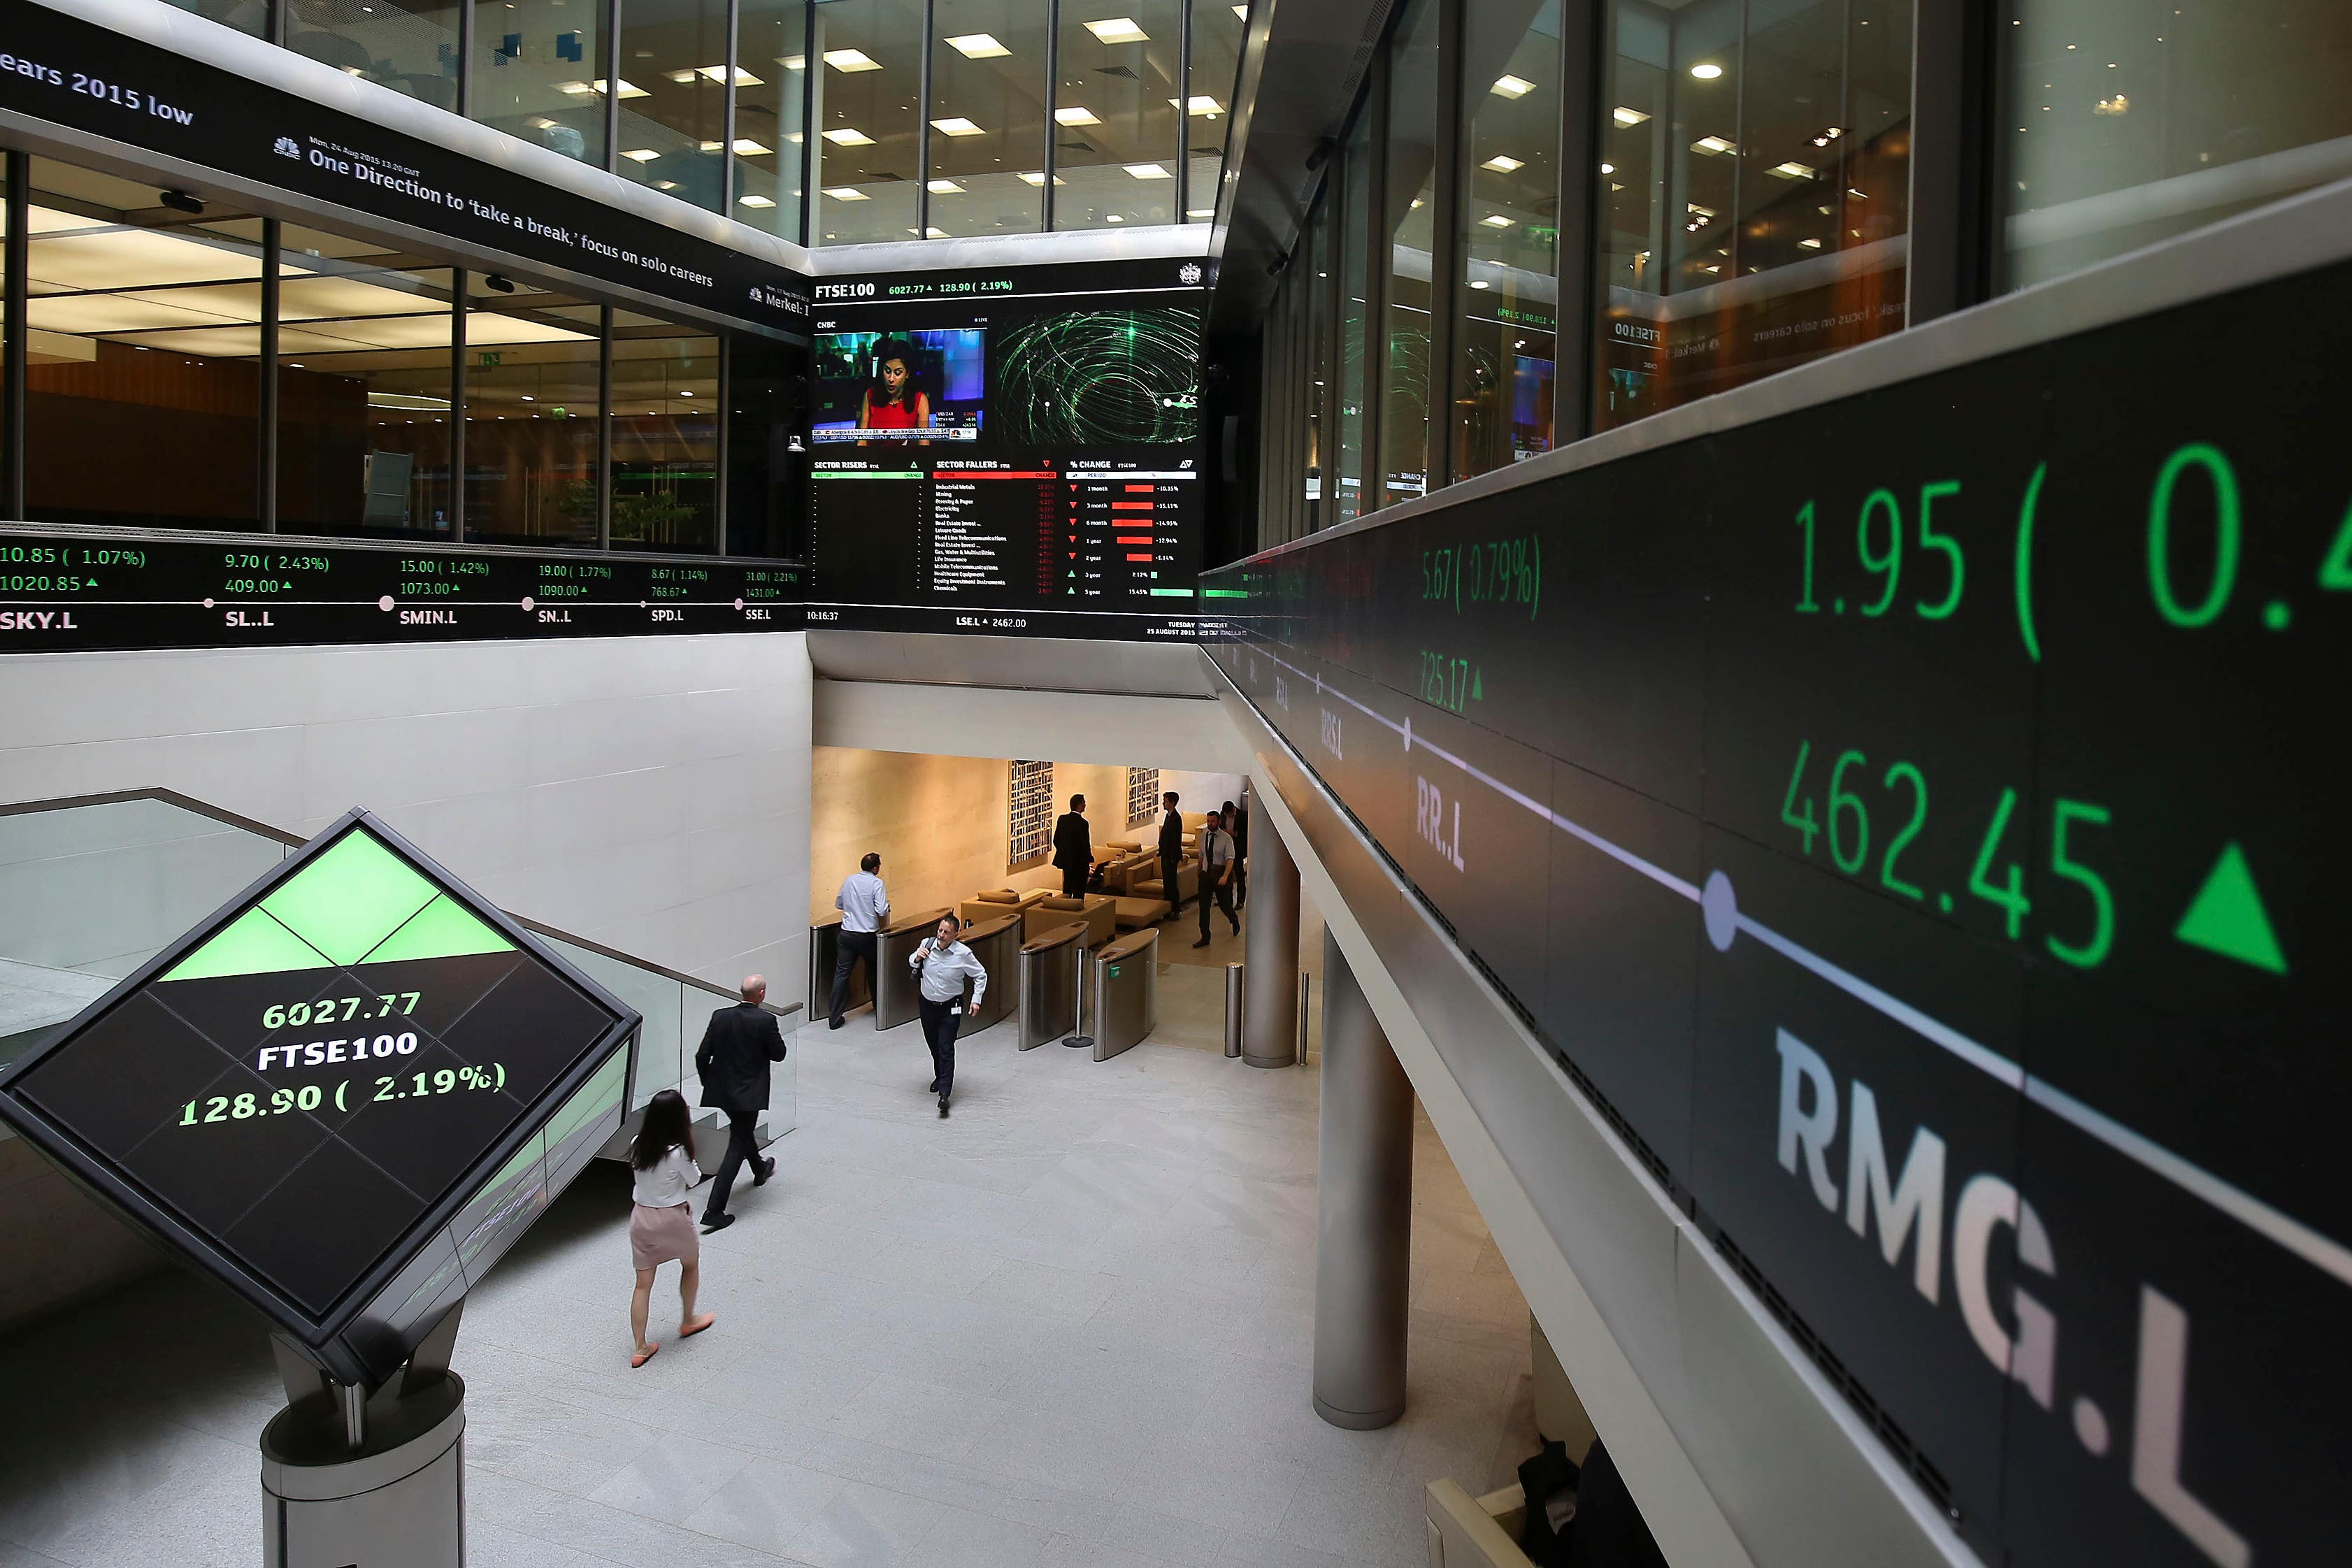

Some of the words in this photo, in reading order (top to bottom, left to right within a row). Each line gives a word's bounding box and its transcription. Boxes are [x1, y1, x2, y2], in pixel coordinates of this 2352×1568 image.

[0, 52, 63, 86] ears
[71, 72, 140, 110] 2015
[148, 95, 194, 127] low
[343, 147, 359, 160] Aug
[360, 152, 380, 165] 2015
[403, 167, 420, 177] GMT
[308, 148, 350, 175] One
[354, 162, 441, 204] Direction
[445, 192, 464, 210] to
[514, 215, 524, 231] a
[581, 234, 618, 259] focus
[622, 250, 638, 266] on
[641, 254, 667, 274] solo
[670, 264, 713, 288] careers
[815, 282, 875, 299] FTSE100
[889, 284, 924, 295] 6027.77
[940, 282, 970, 293] 128.90
[766, 292, 803, 315] Merkel:
[1794, 480, 1965, 619] 1.95
[0, 548, 55, 563] 10.85
[83, 549, 145, 568] 1.07%)
[225, 554, 259, 568] 9.70
[279, 556, 329, 573] 2.43%)
[401, 561, 435, 573] 15.00
[450, 562, 489, 577] 1.42%)
[539, 566, 566, 577] 19.00
[579, 566, 611, 580] 1.77%)
[652, 570, 670, 579] 8.67
[746, 572, 766, 582] 31.00
[1422, 549, 1451, 600] 5.67
[0, 577, 80, 591] 1020.85
[225, 580, 278, 593] 409.00
[401, 583, 450, 595] 1073.00
[539, 586, 578, 596] 1090.00
[652, 587, 680, 597] 768.67
[746, 589, 774, 598] 1431.00
[0, 612, 78, 629] SKY.L
[226, 612, 274, 626] SL..L
[400, 611, 457, 625] SMIN.L
[538, 610, 571, 623] SN..L
[652, 610, 683, 621] SPD.L
[746, 609, 770, 620] SSE.L
[807, 612, 838, 621] 10:16:37
[956, 617, 980, 626] LSE.L
[993, 618, 1026, 628] 2462.00
[1420, 650, 1468, 712] 725.17
[1781, 741, 2115, 968] 462.45
[262, 991, 421, 1029] 6027.77
[258, 1032, 418, 1071] FTSE100
[178, 1085, 322, 1126] 128.90
[373, 1062, 506, 1102] 2.19%)
[1777, 1026, 2251, 1568] RMG.L
